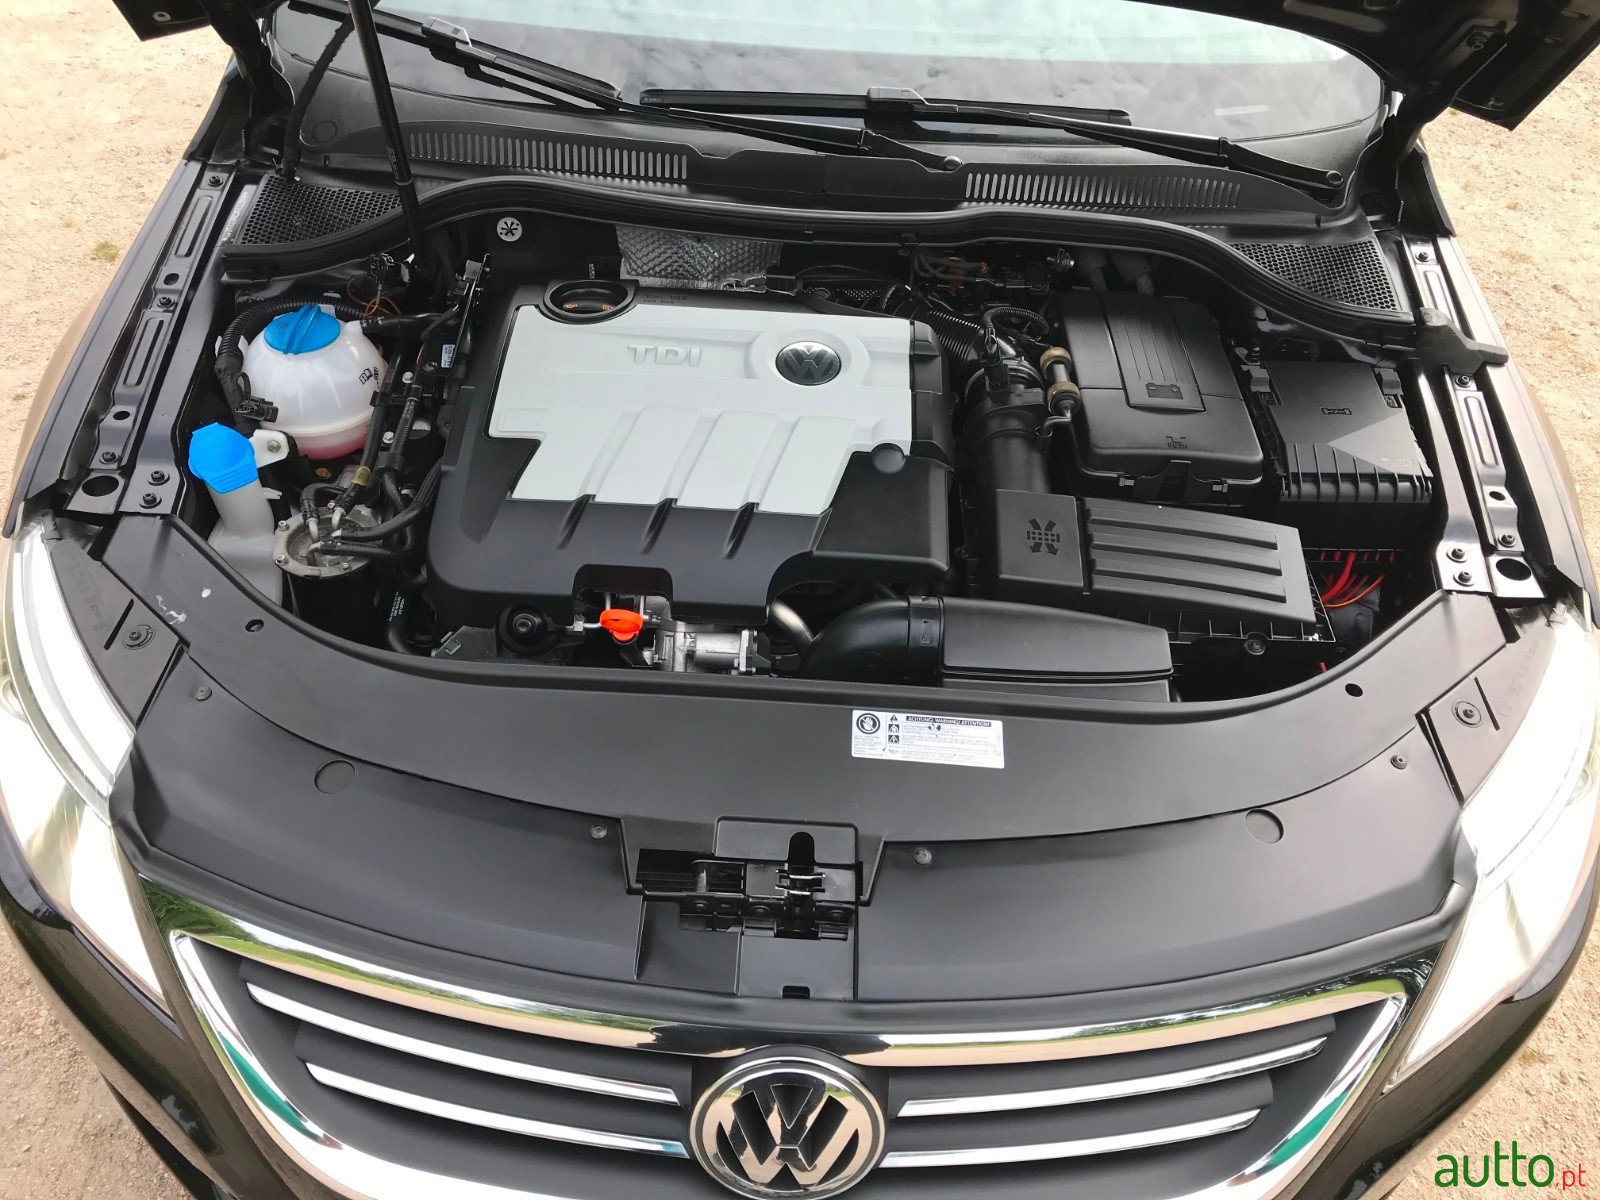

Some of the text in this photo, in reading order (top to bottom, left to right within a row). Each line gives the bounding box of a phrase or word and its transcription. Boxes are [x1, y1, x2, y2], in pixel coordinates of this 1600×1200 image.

[628, 344, 702, 367] TDI
[777, 342, 841, 385] VW
[695, 1064, 878, 1196] VW
